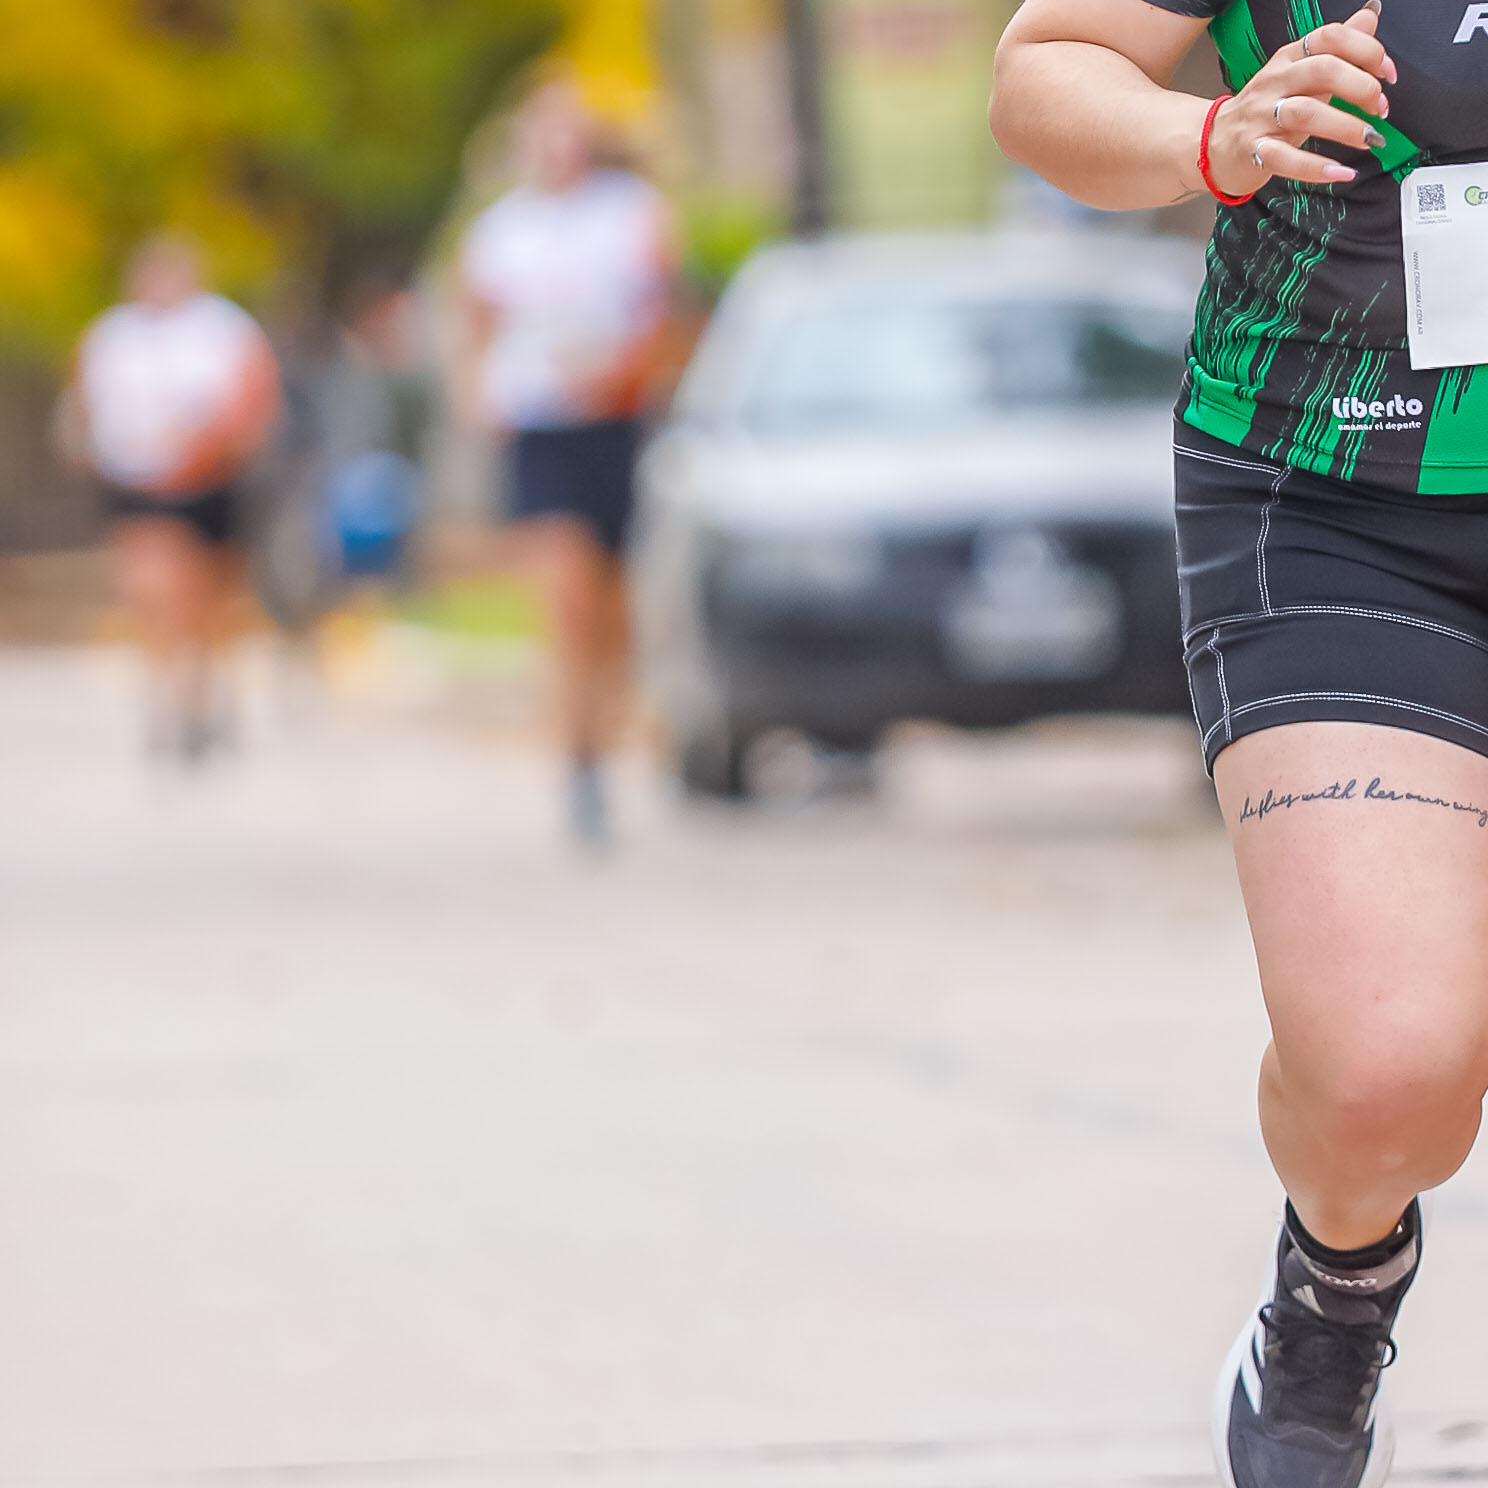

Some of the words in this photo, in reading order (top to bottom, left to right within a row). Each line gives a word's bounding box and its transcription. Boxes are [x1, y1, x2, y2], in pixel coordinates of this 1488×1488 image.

[1374, 423, 1384, 431] el
[1385, 420, 1422, 432] deporte
[1301, 779, 1356, 801] with
[1364, 777, 1403, 801] her
[1405, 792, 1450, 807] own
